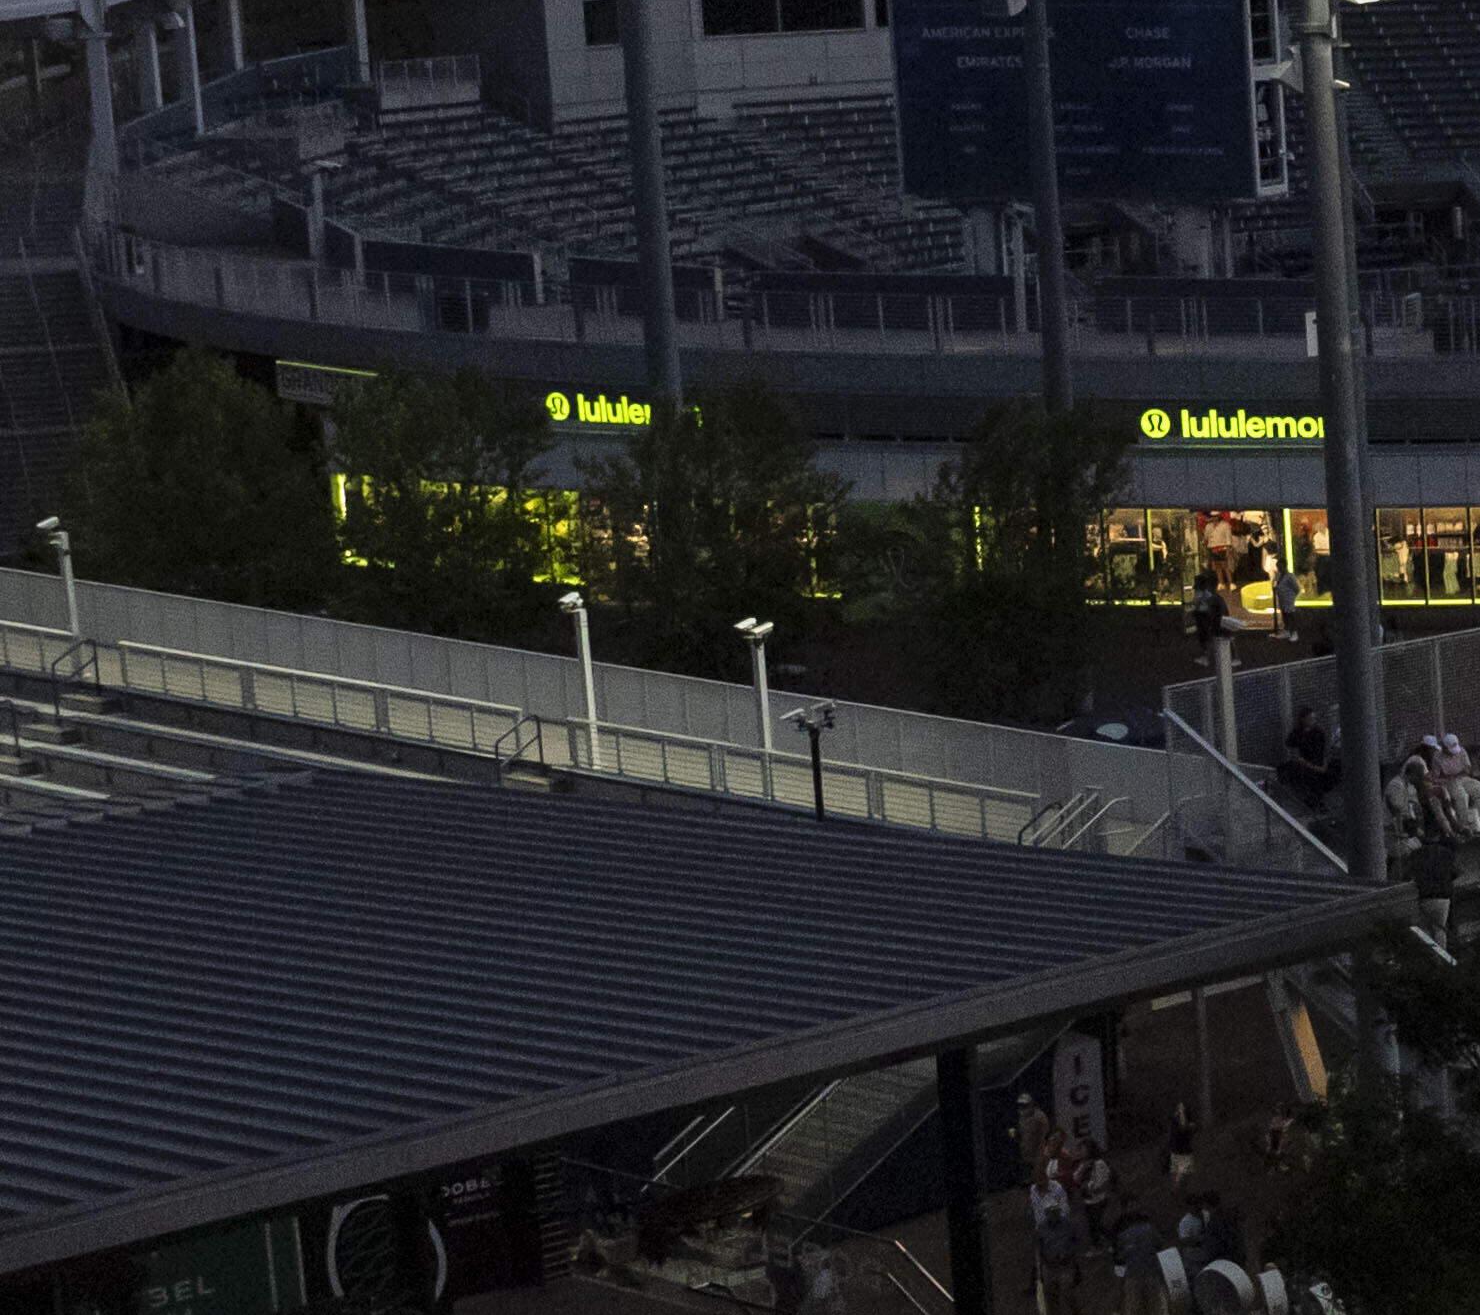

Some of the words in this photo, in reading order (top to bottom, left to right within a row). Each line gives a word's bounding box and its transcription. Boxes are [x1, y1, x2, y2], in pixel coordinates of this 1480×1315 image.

[921, 26, 990, 39] AMERICAN
[1126, 26, 1170, 39] CHASE
[957, 56, 1023, 68] EMIRATES
[1133, 56, 1192, 69] MORGAN
